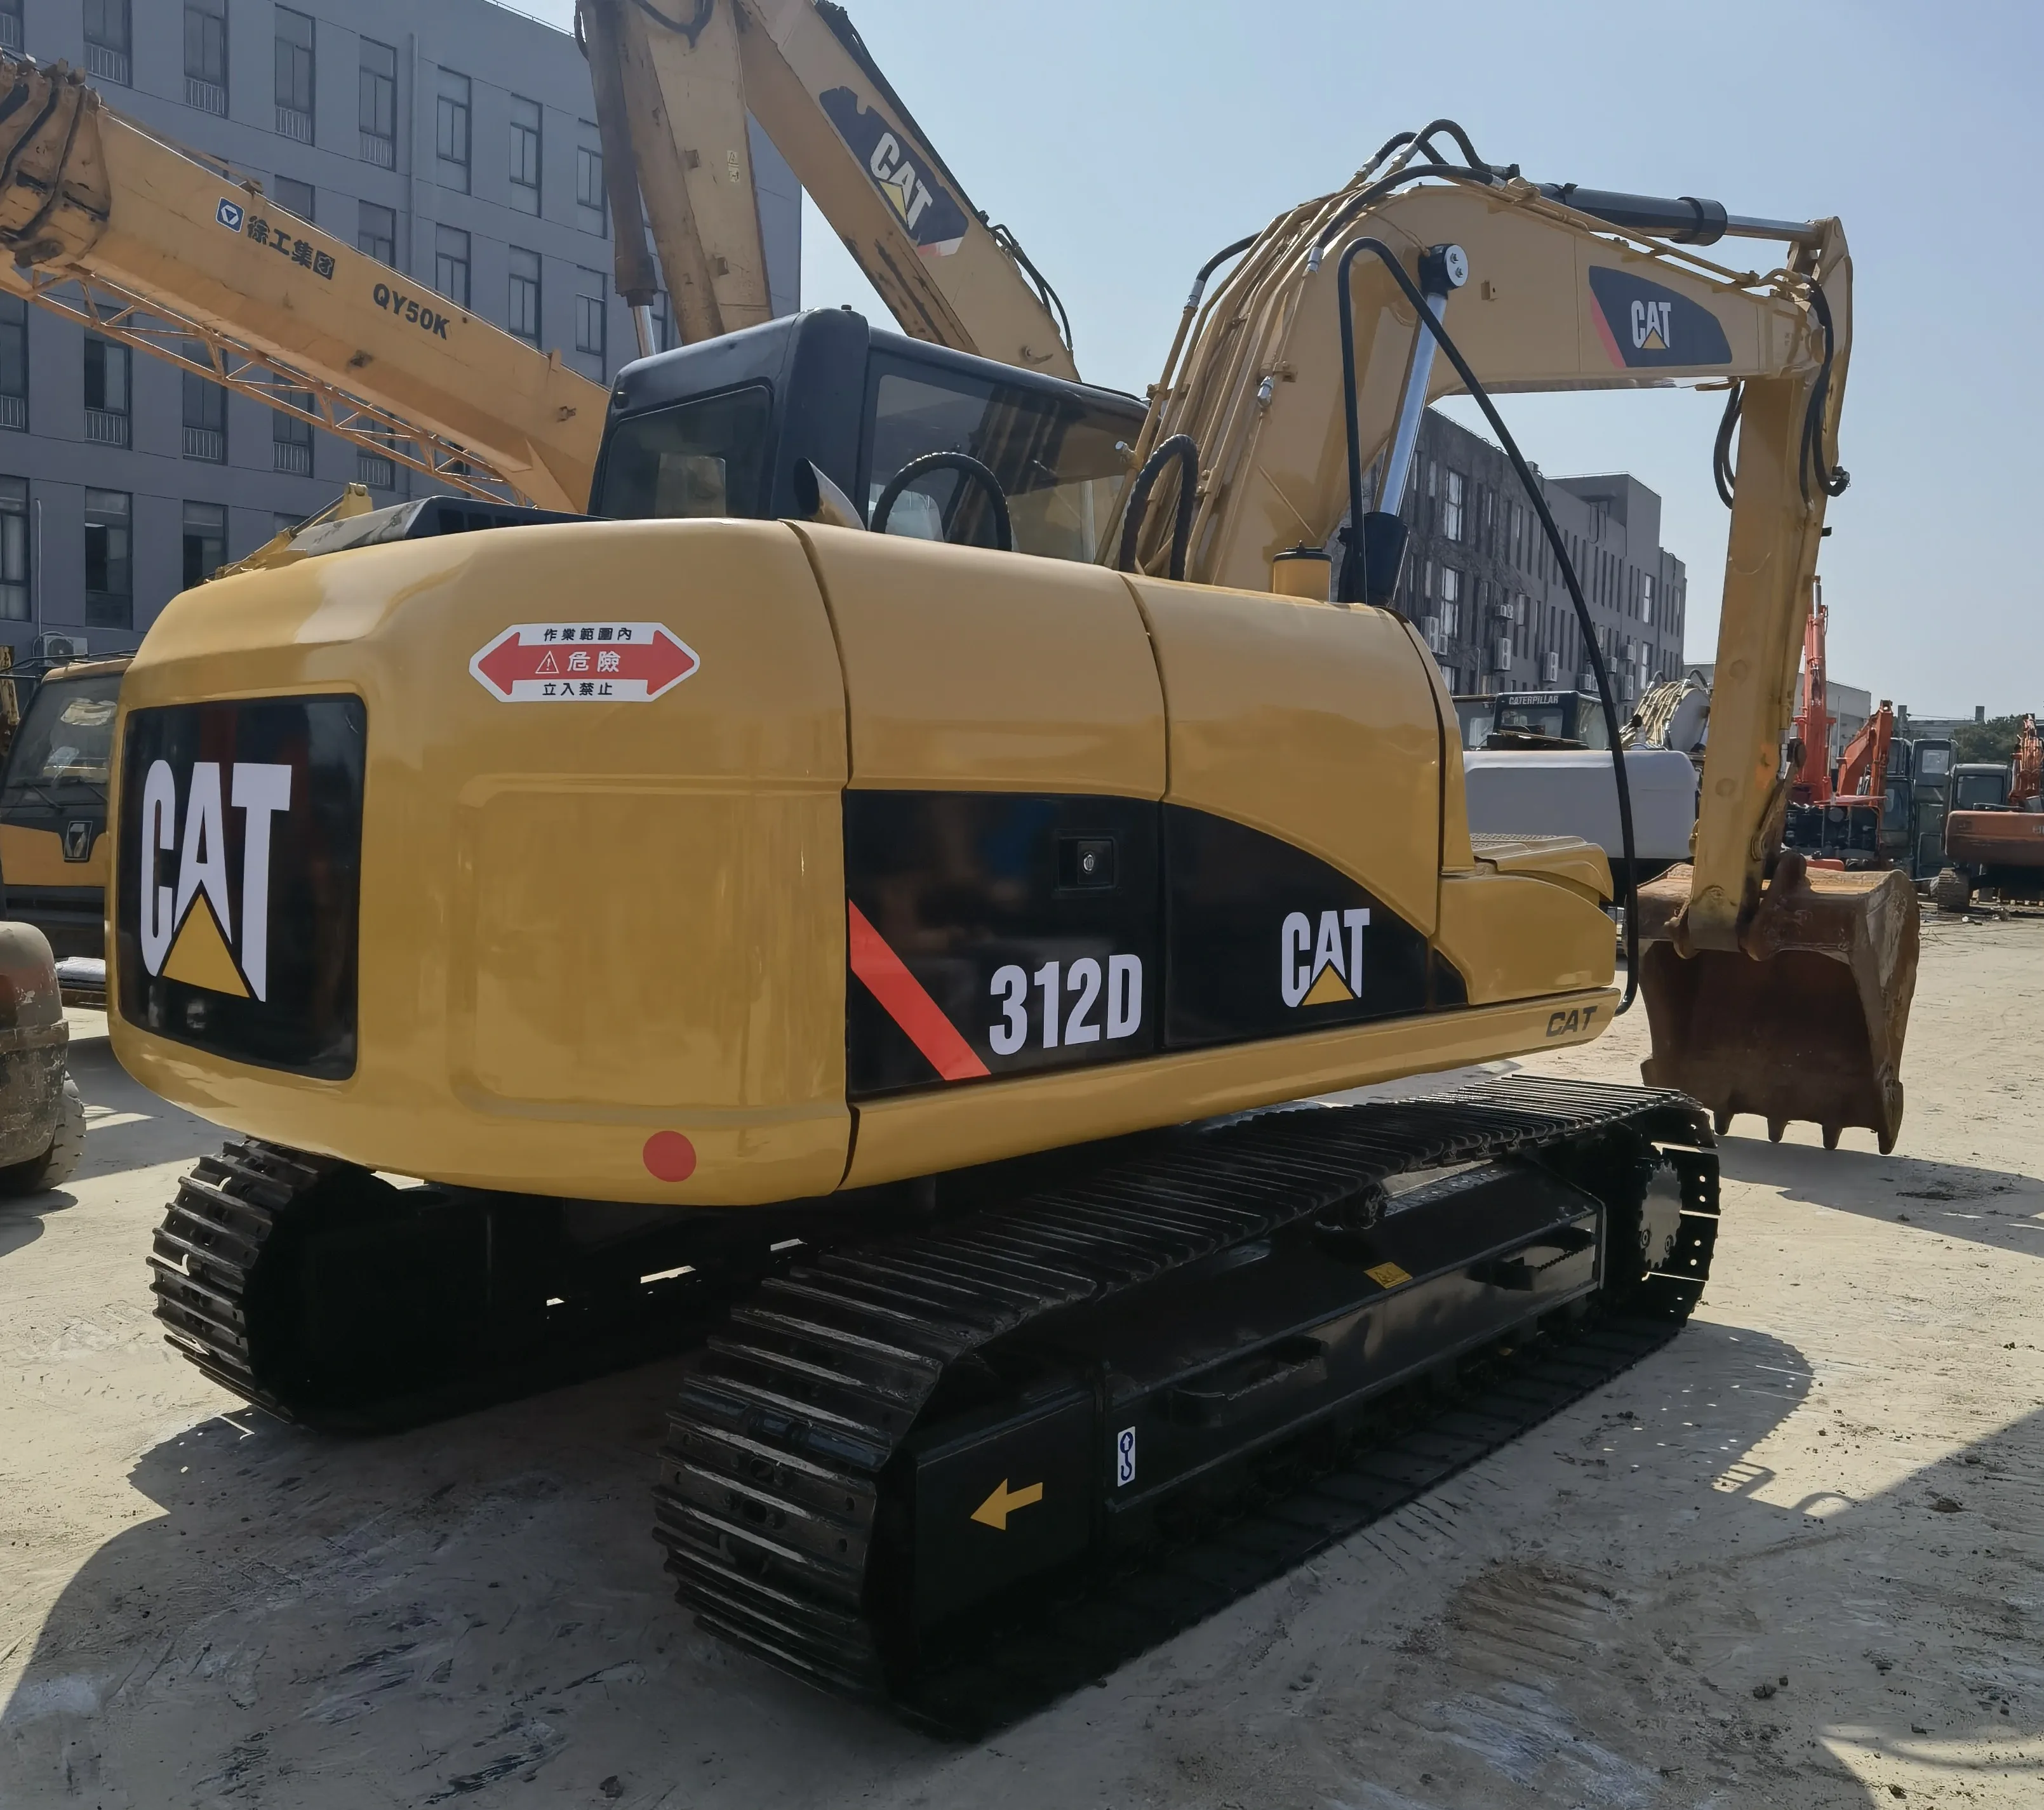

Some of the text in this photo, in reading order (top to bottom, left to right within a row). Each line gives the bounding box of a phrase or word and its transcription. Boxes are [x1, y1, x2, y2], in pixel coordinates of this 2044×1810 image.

[870, 132, 933, 230] CAT
[246, 215, 335, 280] 徐工集团
[373, 283, 450, 340] QY50K
[1631, 300, 1671, 349] CAT
[542, 682, 613, 696] 立入禁止
[567, 651, 621, 672] 危險
[1509, 695, 1558, 705] CATERPILLAR
[140, 759, 292, 1002] CAT
[1281, 908, 1370, 1008] CAT
[989, 954, 1142, 1055] 312D
[1546, 1006, 1598, 1037] CAT
